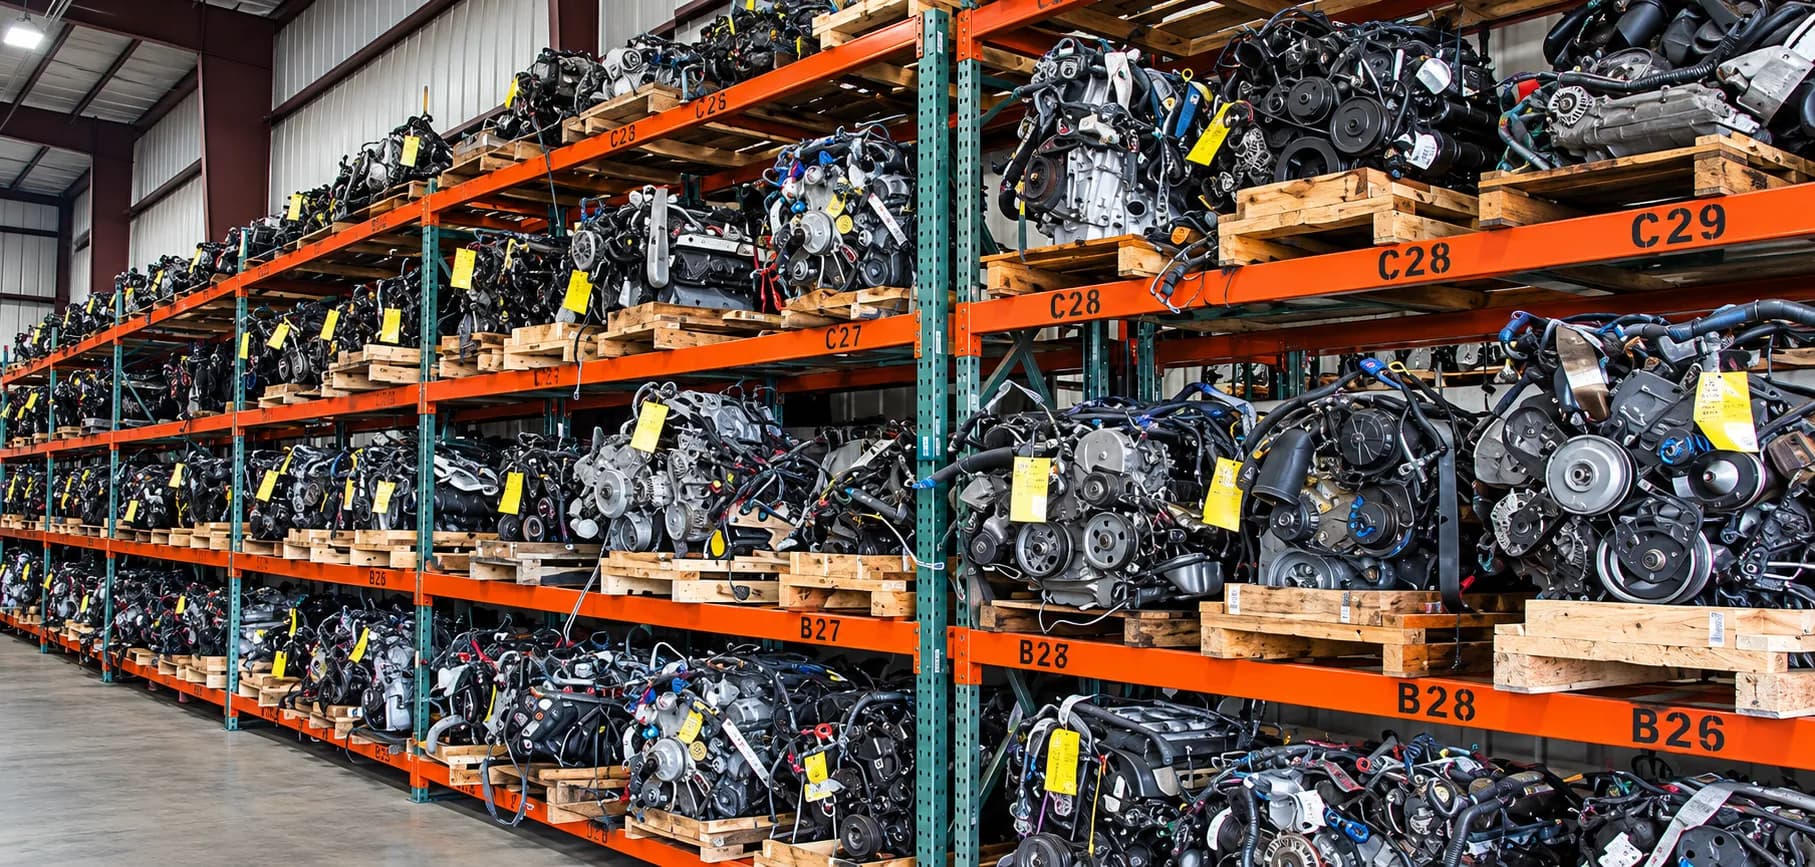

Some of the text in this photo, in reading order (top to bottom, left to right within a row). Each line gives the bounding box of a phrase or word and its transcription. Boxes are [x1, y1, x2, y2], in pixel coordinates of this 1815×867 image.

[1631, 203, 1726, 249] C29
[1378, 242, 1451, 281] C28
[1050, 289, 1101, 319] C28
[826, 325, 862, 350] C27
[800, 616, 841, 642] B27
[1398, 682, 1476, 722] B28
[1632, 707, 1726, 753] B26
